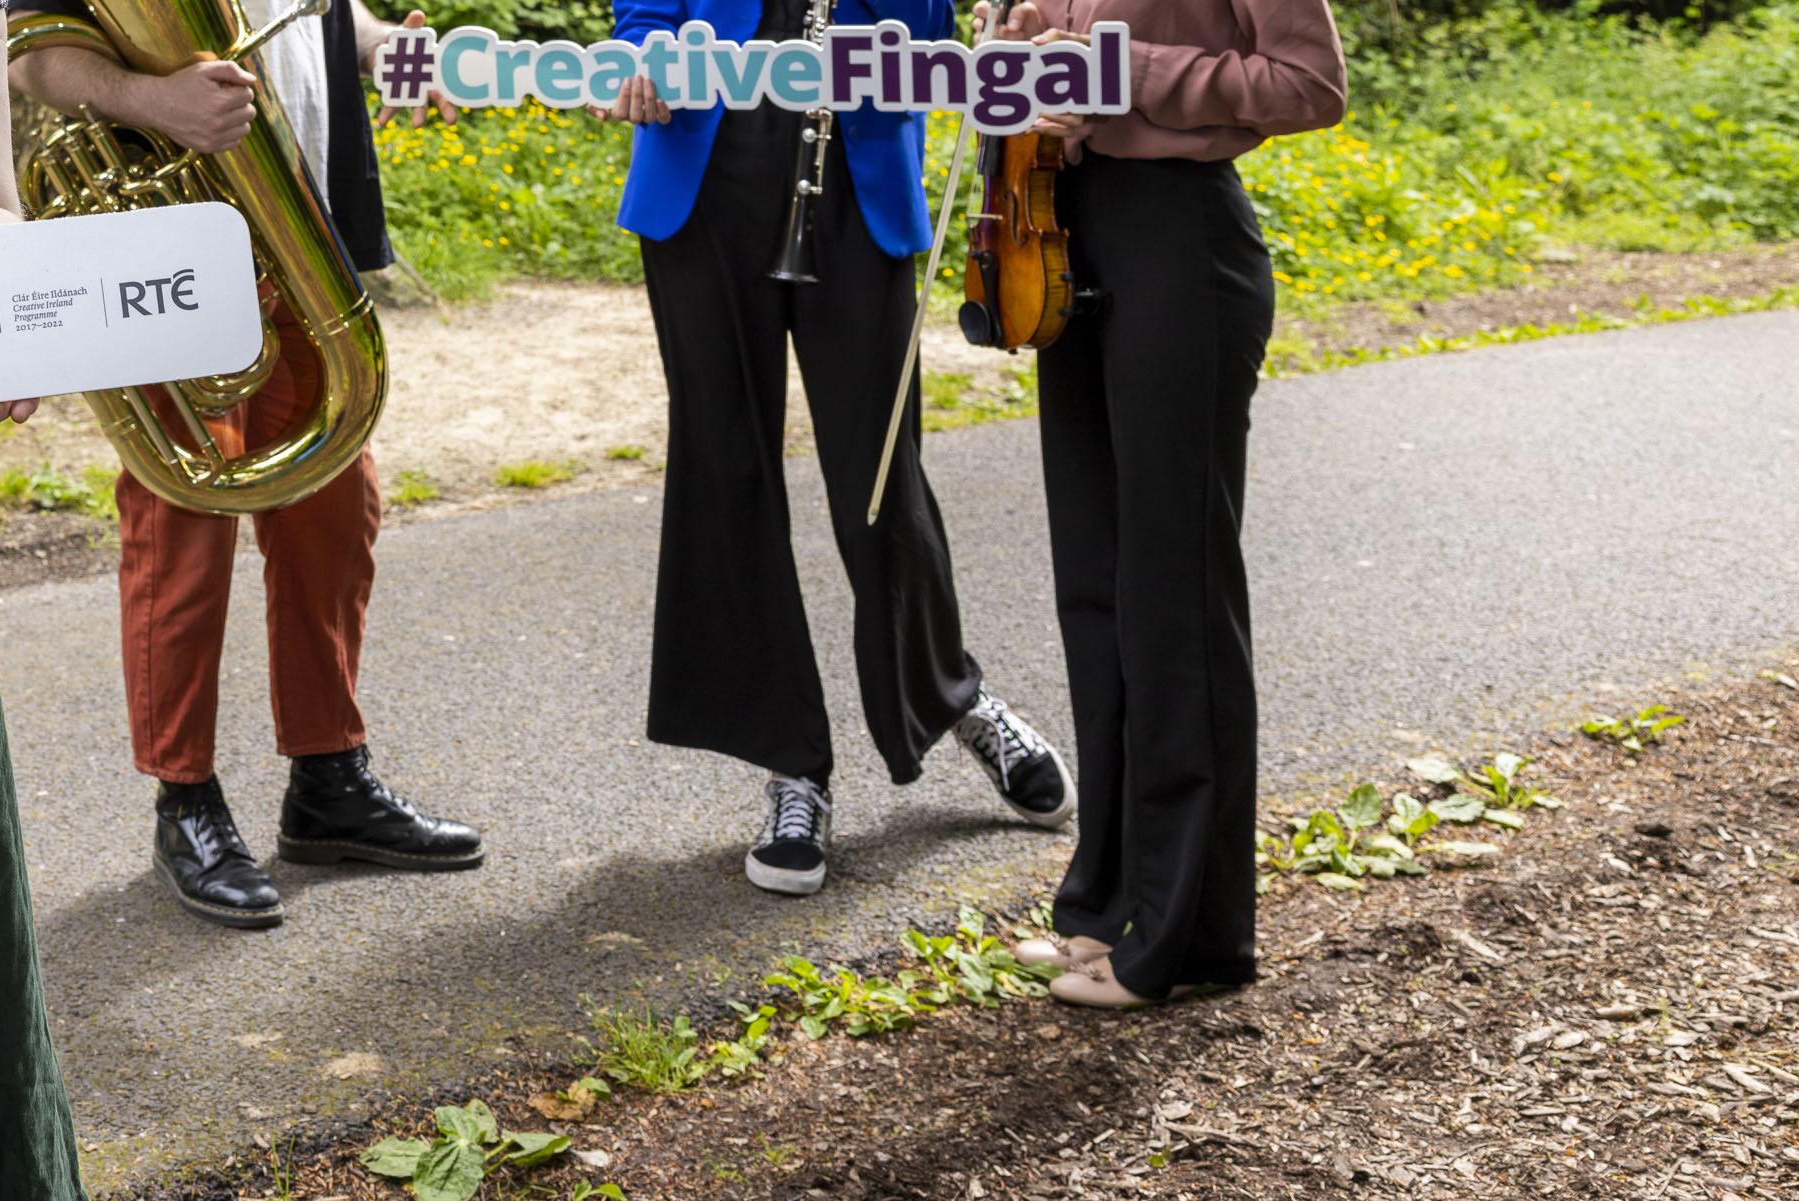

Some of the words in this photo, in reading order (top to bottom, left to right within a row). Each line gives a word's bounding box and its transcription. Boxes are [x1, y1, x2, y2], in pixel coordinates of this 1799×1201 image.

[383, 30, 1121, 127] #CreativeFingal
[12, 294, 30, 303] Clár
[32, 290, 49, 301] Éire
[51, 286, 88, 299] Ildánach
[119, 269, 199, 319] RTÉ
[13, 302, 45, 313] Creative
[46, 298, 73, 309] Ireland
[14, 311, 58, 322] Programme
